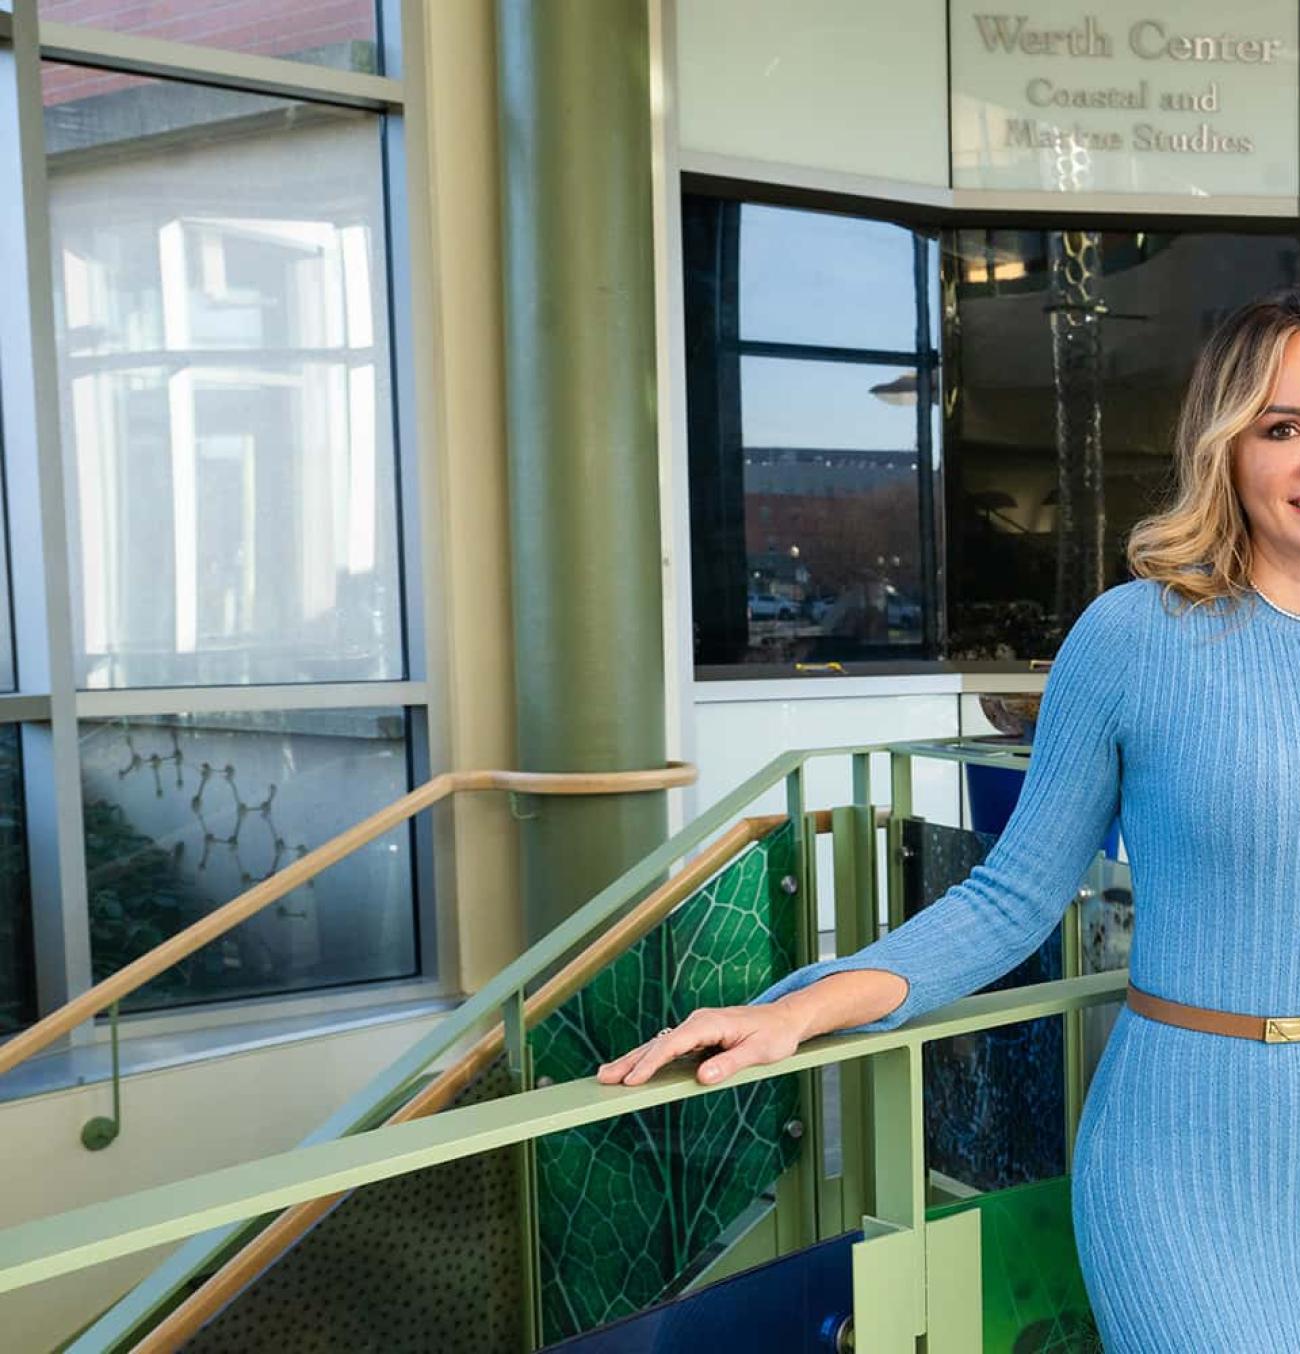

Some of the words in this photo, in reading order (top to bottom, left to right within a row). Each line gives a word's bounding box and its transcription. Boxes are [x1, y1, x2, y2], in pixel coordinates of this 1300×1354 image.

[973, 14, 1113, 58] Werth
[1129, 19, 1282, 64] Center
[1025, 78, 1148, 110] Coastal
[1160, 82, 1222, 113] and
[1131, 123, 1254, 154] Studies
